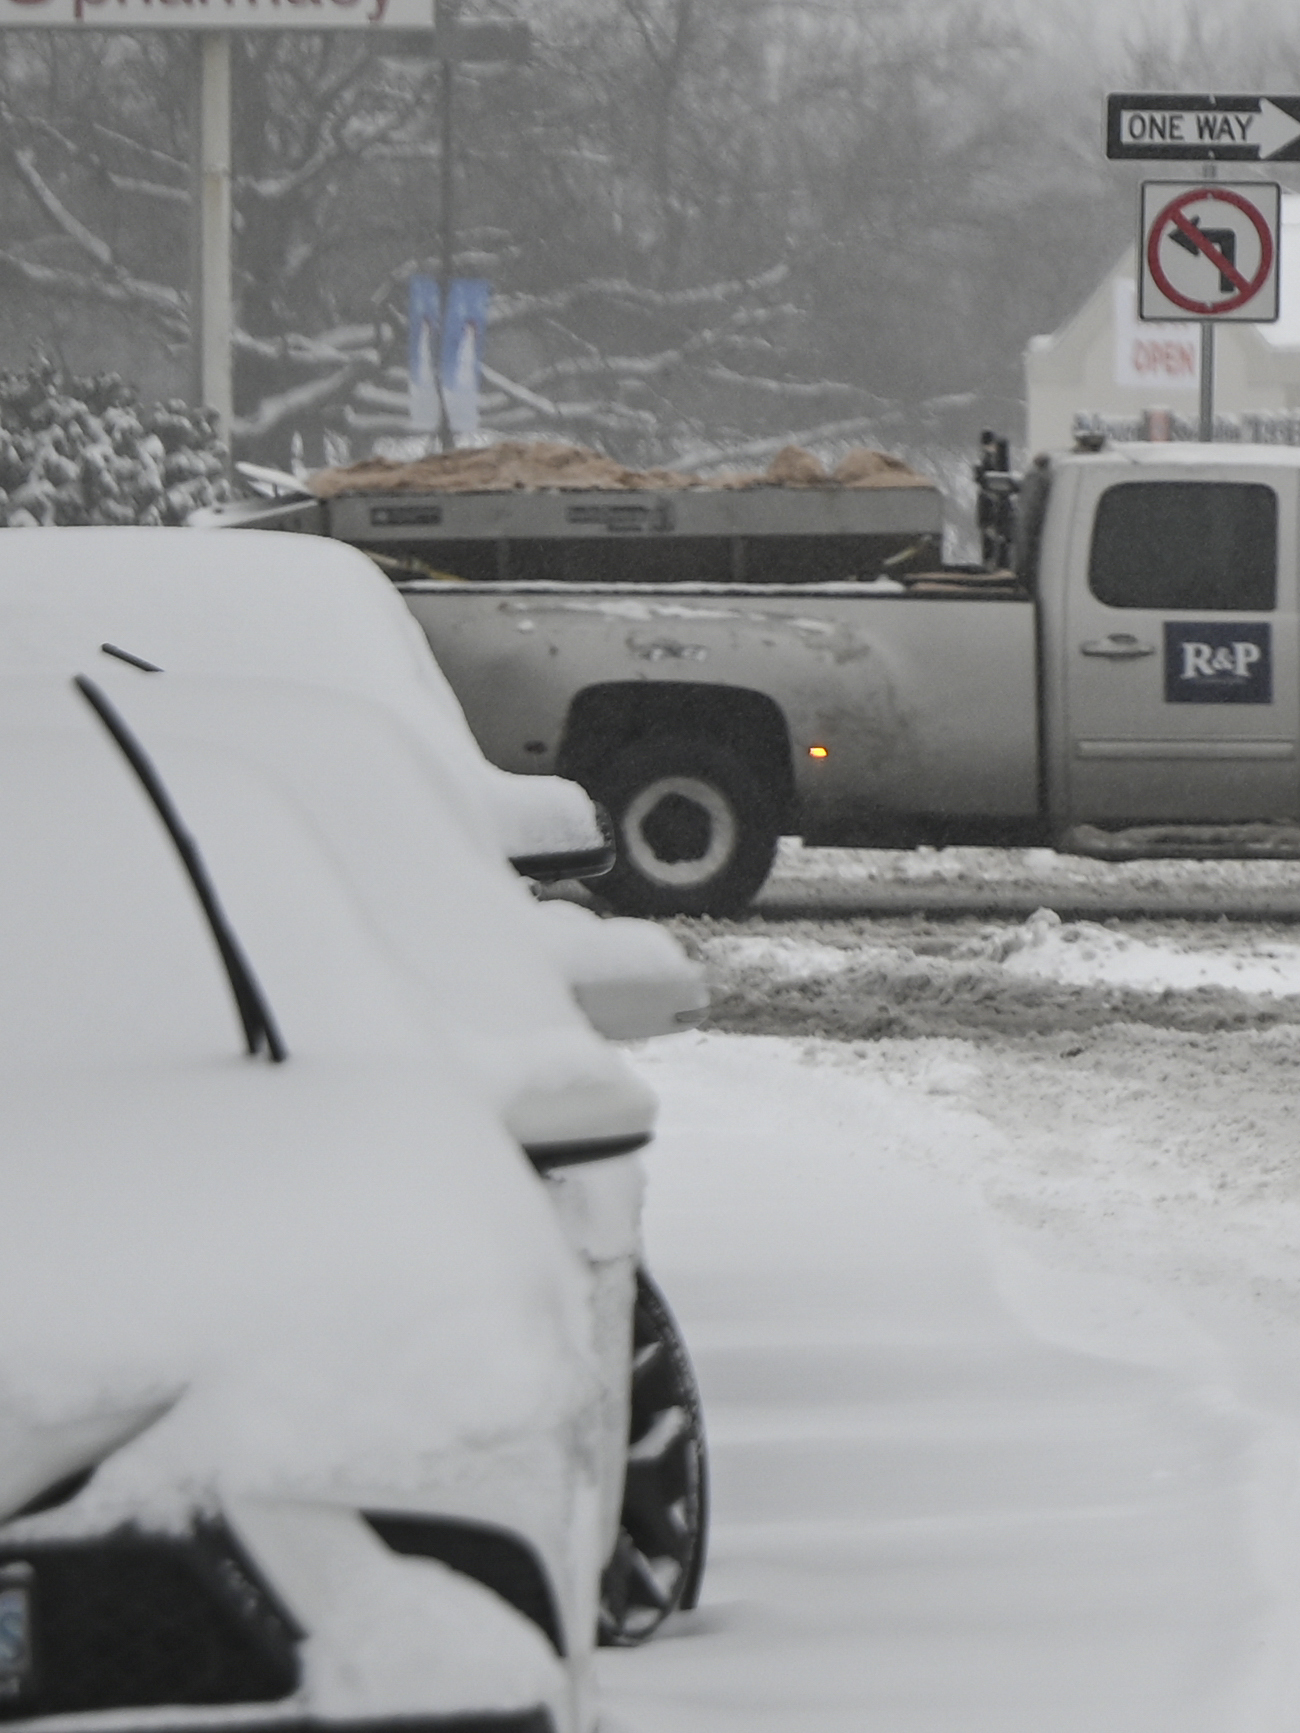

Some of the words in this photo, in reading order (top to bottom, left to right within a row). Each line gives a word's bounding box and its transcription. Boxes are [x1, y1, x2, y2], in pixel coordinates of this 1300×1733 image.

[1128, 112, 1184, 141] ONE
[1196, 113, 1253, 142] WAY
[1133, 340, 1195, 376] OPEN
[1180, 641, 1261, 680] R&P
